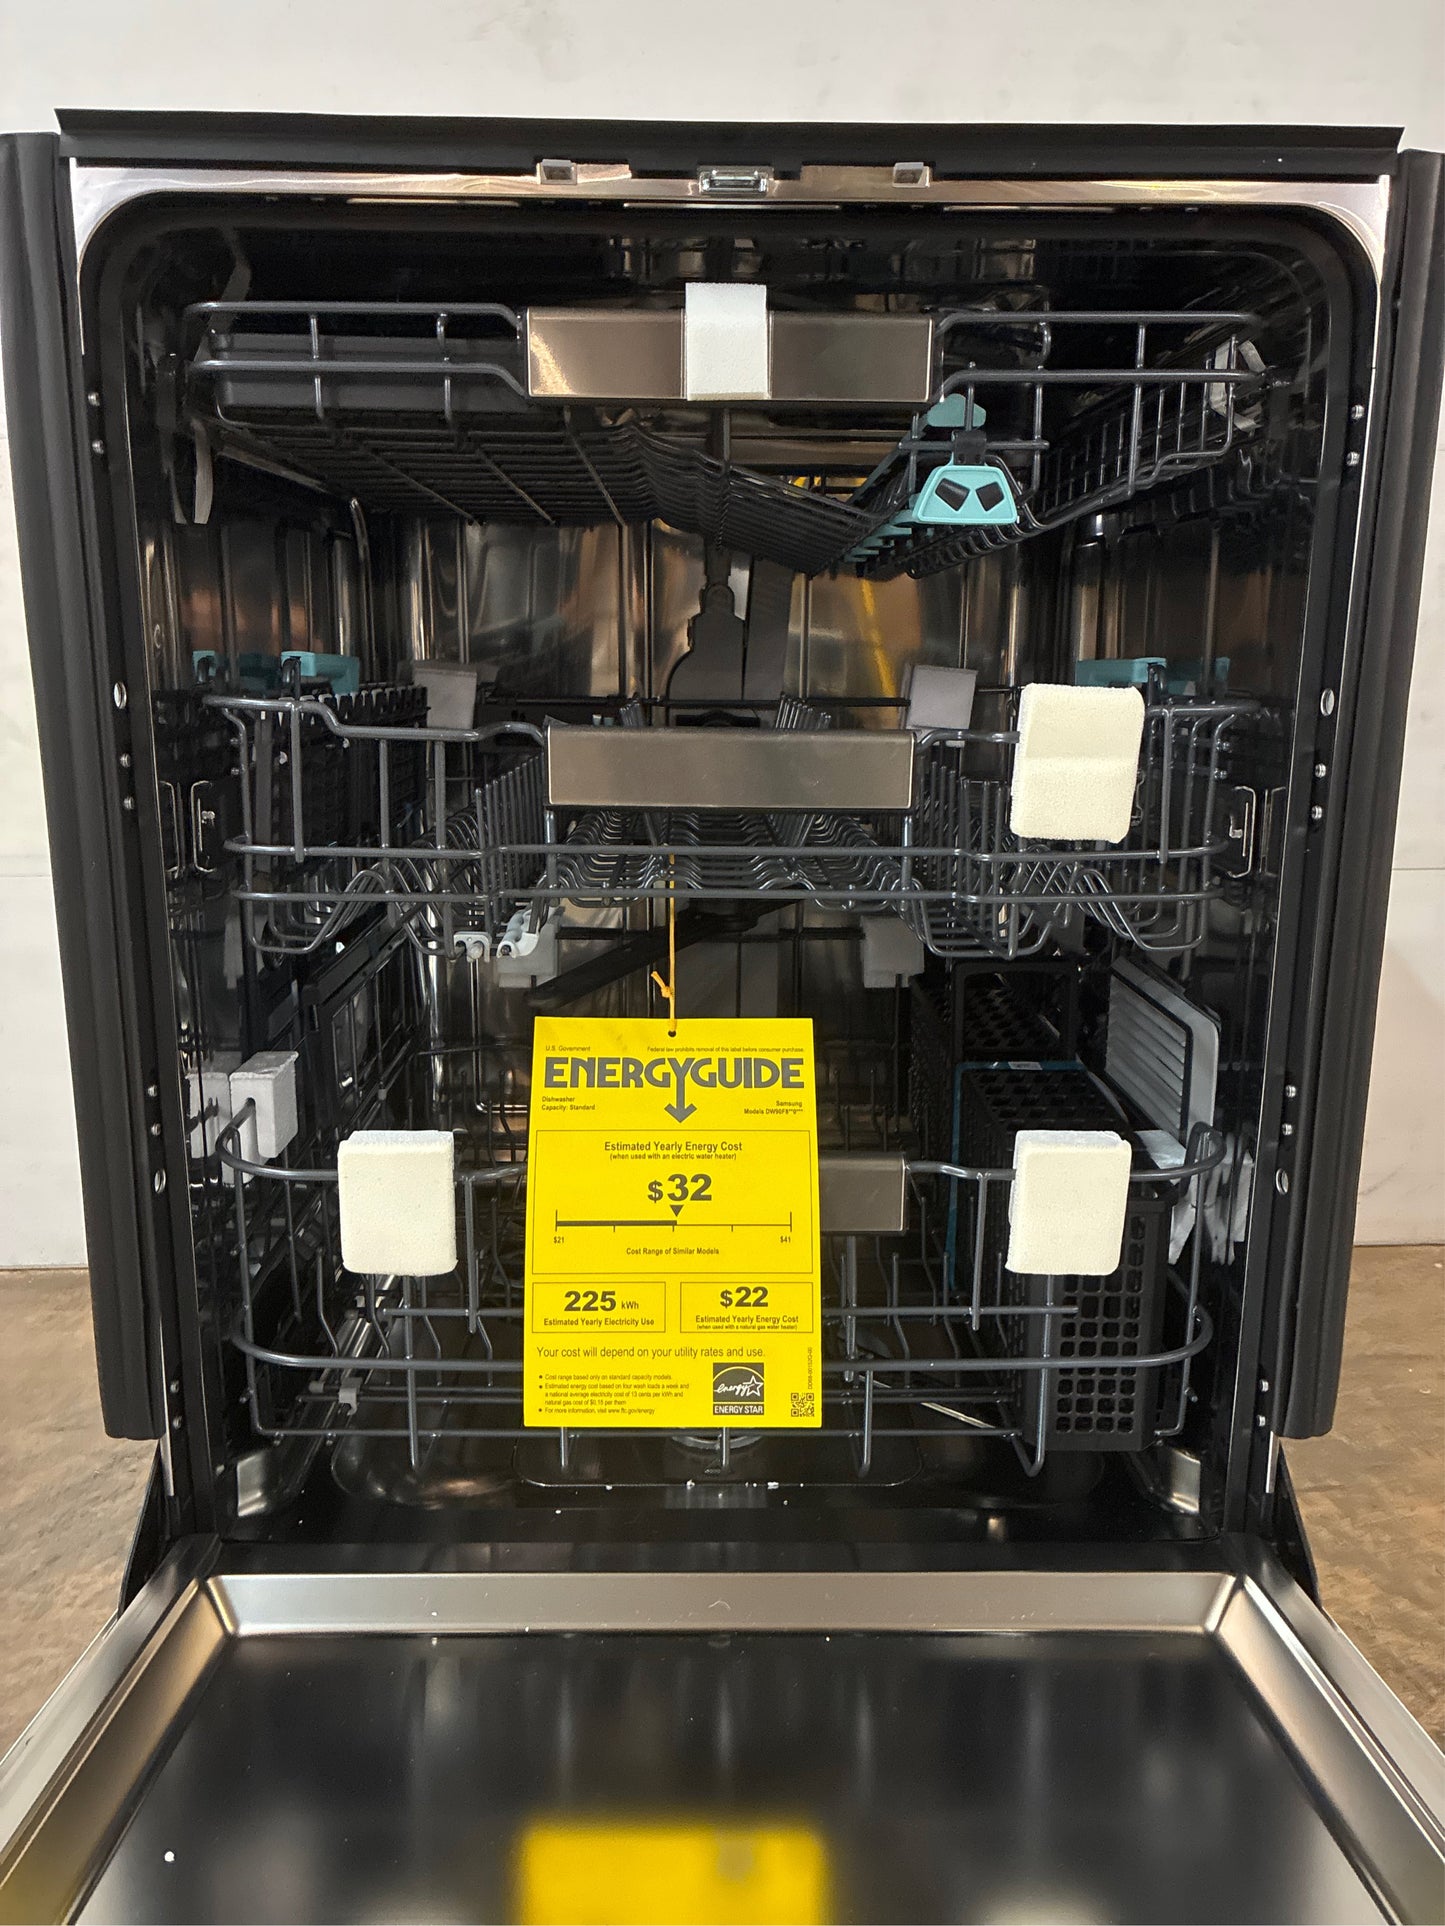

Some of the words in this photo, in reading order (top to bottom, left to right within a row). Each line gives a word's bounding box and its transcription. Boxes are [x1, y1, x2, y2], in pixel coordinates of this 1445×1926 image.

[544, 1057, 804, 1088] ENERGYGUIDE
[542, 1104, 568, 1112] Capacity:
[604, 1142, 651, 1151] Estimated
[654, 1142, 682, 1153] Yearly
[686, 1142, 718, 1153] Energy
[720, 1142, 743, 1151] Cost
[648, 1174, 712, 1203] $32
[554, 1236, 565, 1244] $21
[643, 1248, 664, 1256] Range
[564, 1290, 617, 1312] 225
[621, 1301, 639, 1310] kWh
[720, 1286, 769, 1308] $22
[544, 1318, 579, 1326] Estimated
[580, 1318, 602, 1327] Yearly
[604, 1318, 639, 1327] Electricity
[641, 1318, 655, 1326] Use
[696, 1315, 731, 1323] Estimated
[733, 1315, 754, 1324] Yearly
[756, 1315, 780, 1324] Energy
[782, 1315, 799, 1323] Cost
[537, 1347, 559, 1357] Your
[561, 1347, 580, 1357] cost
[583, 1347, 598, 1357] will
[600, 1347, 635, 1359] depend
[637, 1349, 649, 1357] on
[652, 1349, 672, 1359] your
[675, 1347, 698, 1359] utility
[701, 1347, 725, 1357] rates
[727, 1347, 744, 1357] and
[746, 1349, 765, 1357] use.
[714, 1406, 743, 1414] ENERGY
[744, 1406, 763, 1414] STAR
